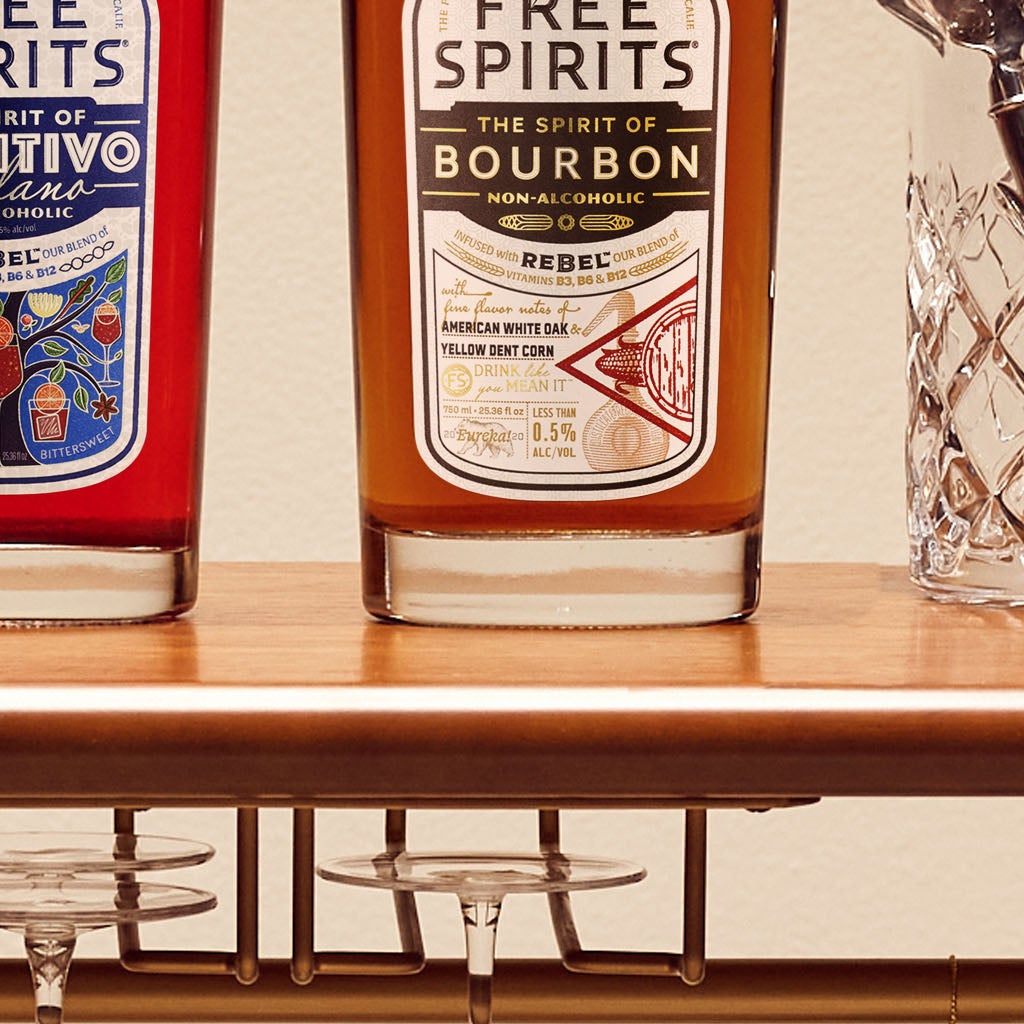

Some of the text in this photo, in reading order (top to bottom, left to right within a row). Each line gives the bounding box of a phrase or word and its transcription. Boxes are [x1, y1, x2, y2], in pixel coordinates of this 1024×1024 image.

[439, 9, 448, 32] THE
[54, 109, 87, 126] OF
[477, 116, 657, 133] THE SPIRIT OF
[434, 144, 699, 181] BOURBON
[487, 192, 645, 204] NON-ALCOHOLIC
[42, 245, 65, 259] OUR
[66, 233, 97, 253] BLEND
[98, 225, 109, 238] of
[454, 229, 495, 256] INFUSED
[496, 249, 519, 263] with
[613, 250, 636, 263] OUR
[637, 236, 669, 257] BLEND
[669, 228, 680, 242] of
[7, 271, 23, 282] B6
[26, 270, 34, 280] &
[36, 265, 57, 278] B12
[506, 269, 628, 288] VITAMINS B3, B6 & B12
[441, 298, 581, 324] fine flavor notes of
[442, 321, 582, 335] AMERICAN WHITE OAK &
[441, 343, 555, 357] YELLOW DENT CORN
[474, 362, 551, 377] DRINK like
[447, 373, 467, 388] FS
[475, 385, 504, 401] you
[506, 379, 549, 393] MEAN
[443, 405, 459, 414] 750
[461, 405, 472, 414] ml
[479, 407, 503, 415] 25.36
[504, 407, 511, 415] fl
[532, 407, 576, 418] LESS THAN
[444, 428, 524, 443] 20 Eureka! 20
[532, 422, 576, 443] 0.5%
[40, 426, 115, 460] BITTERSWEET
